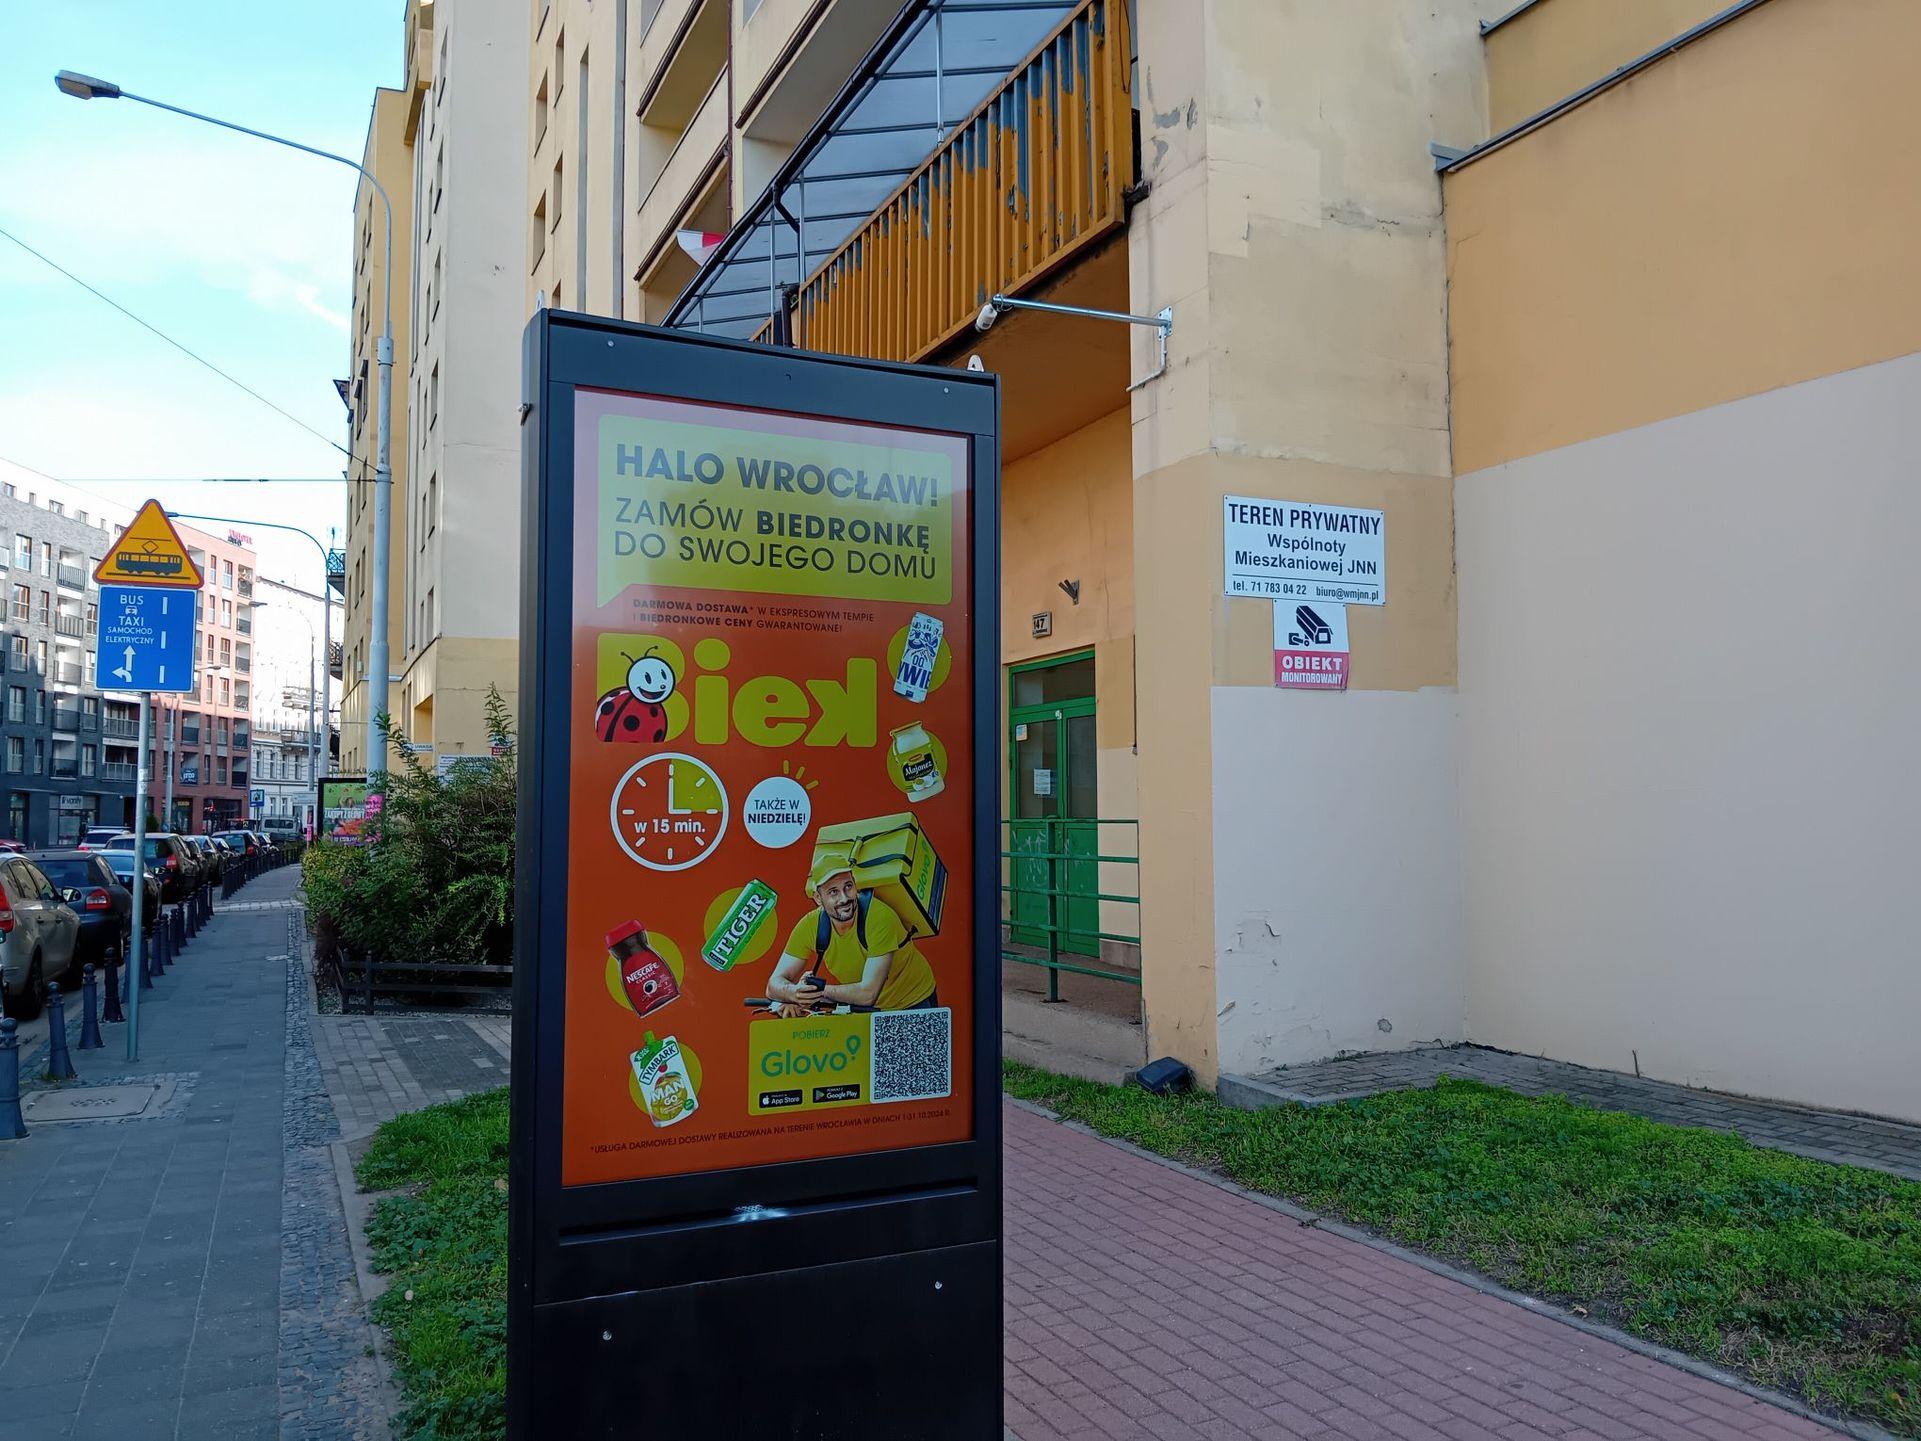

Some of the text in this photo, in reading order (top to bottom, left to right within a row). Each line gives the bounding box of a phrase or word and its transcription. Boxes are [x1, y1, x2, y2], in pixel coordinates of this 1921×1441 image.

[616, 443, 939, 507] HALO WROCŁAW!
[615, 497, 930, 554] ZAMÓW BIEDRONKĘ
[1229, 504, 1380, 535] TEREN PRYWATNY
[1267, 533, 1346, 557] Wspólnoty
[614, 531, 936, 580] DO SWOJEGO DOMU
[1235, 551, 1377, 575] Mieszkaniowej JNN
[120, 595, 144, 605] BUS
[1233, 581, 1379, 601] tel. 71 783 04 22 biuro@wmjnn.pl
[633, 599, 692, 611] DARMOWA
[758, 607, 767, 615] W
[770, 608, 840, 620] EKSPRESOWYM
[843, 612, 874, 622] TEMPIE
[118, 616, 144, 627] TAXI
[640, 613, 721, 626] BIEDRONKOWE
[725, 618, 753, 627] CENY
[757, 619, 842, 633] GWARANTOWANE!
[106, 635, 154, 645] ELEKTRYCZNY
[1282, 656, 1342, 671] OBIEKT
[1282, 671, 1342, 684] MONITOROWANY
[754, 798, 800, 811] TAKŻE W
[634, 819, 706, 834] w 15 min.
[748, 812, 806, 826] NIEDZIELĘ!
[715, 893, 767, 955] TIGER
[793, 1029, 830, 1039] POBIERZ
[642, 1045, 676, 1082] TYMBARK
[761, 1049, 848, 1077] Glovo
[664, 1095, 678, 1105] GO
[827, 1090, 858, 1100] Google Play
[629, 1139, 676, 1150] DARMOWEJ
[679, 1134, 717, 1145] DOSTAWY
[718, 1129, 771, 1140] REALIZOWANA
[787, 1123, 814, 1133] TERENIE
[816, 1118, 861, 1129] WROCŁAWIA
[864, 1118, 870, 1126] W
[873, 1114, 900, 1124] DNIACH
